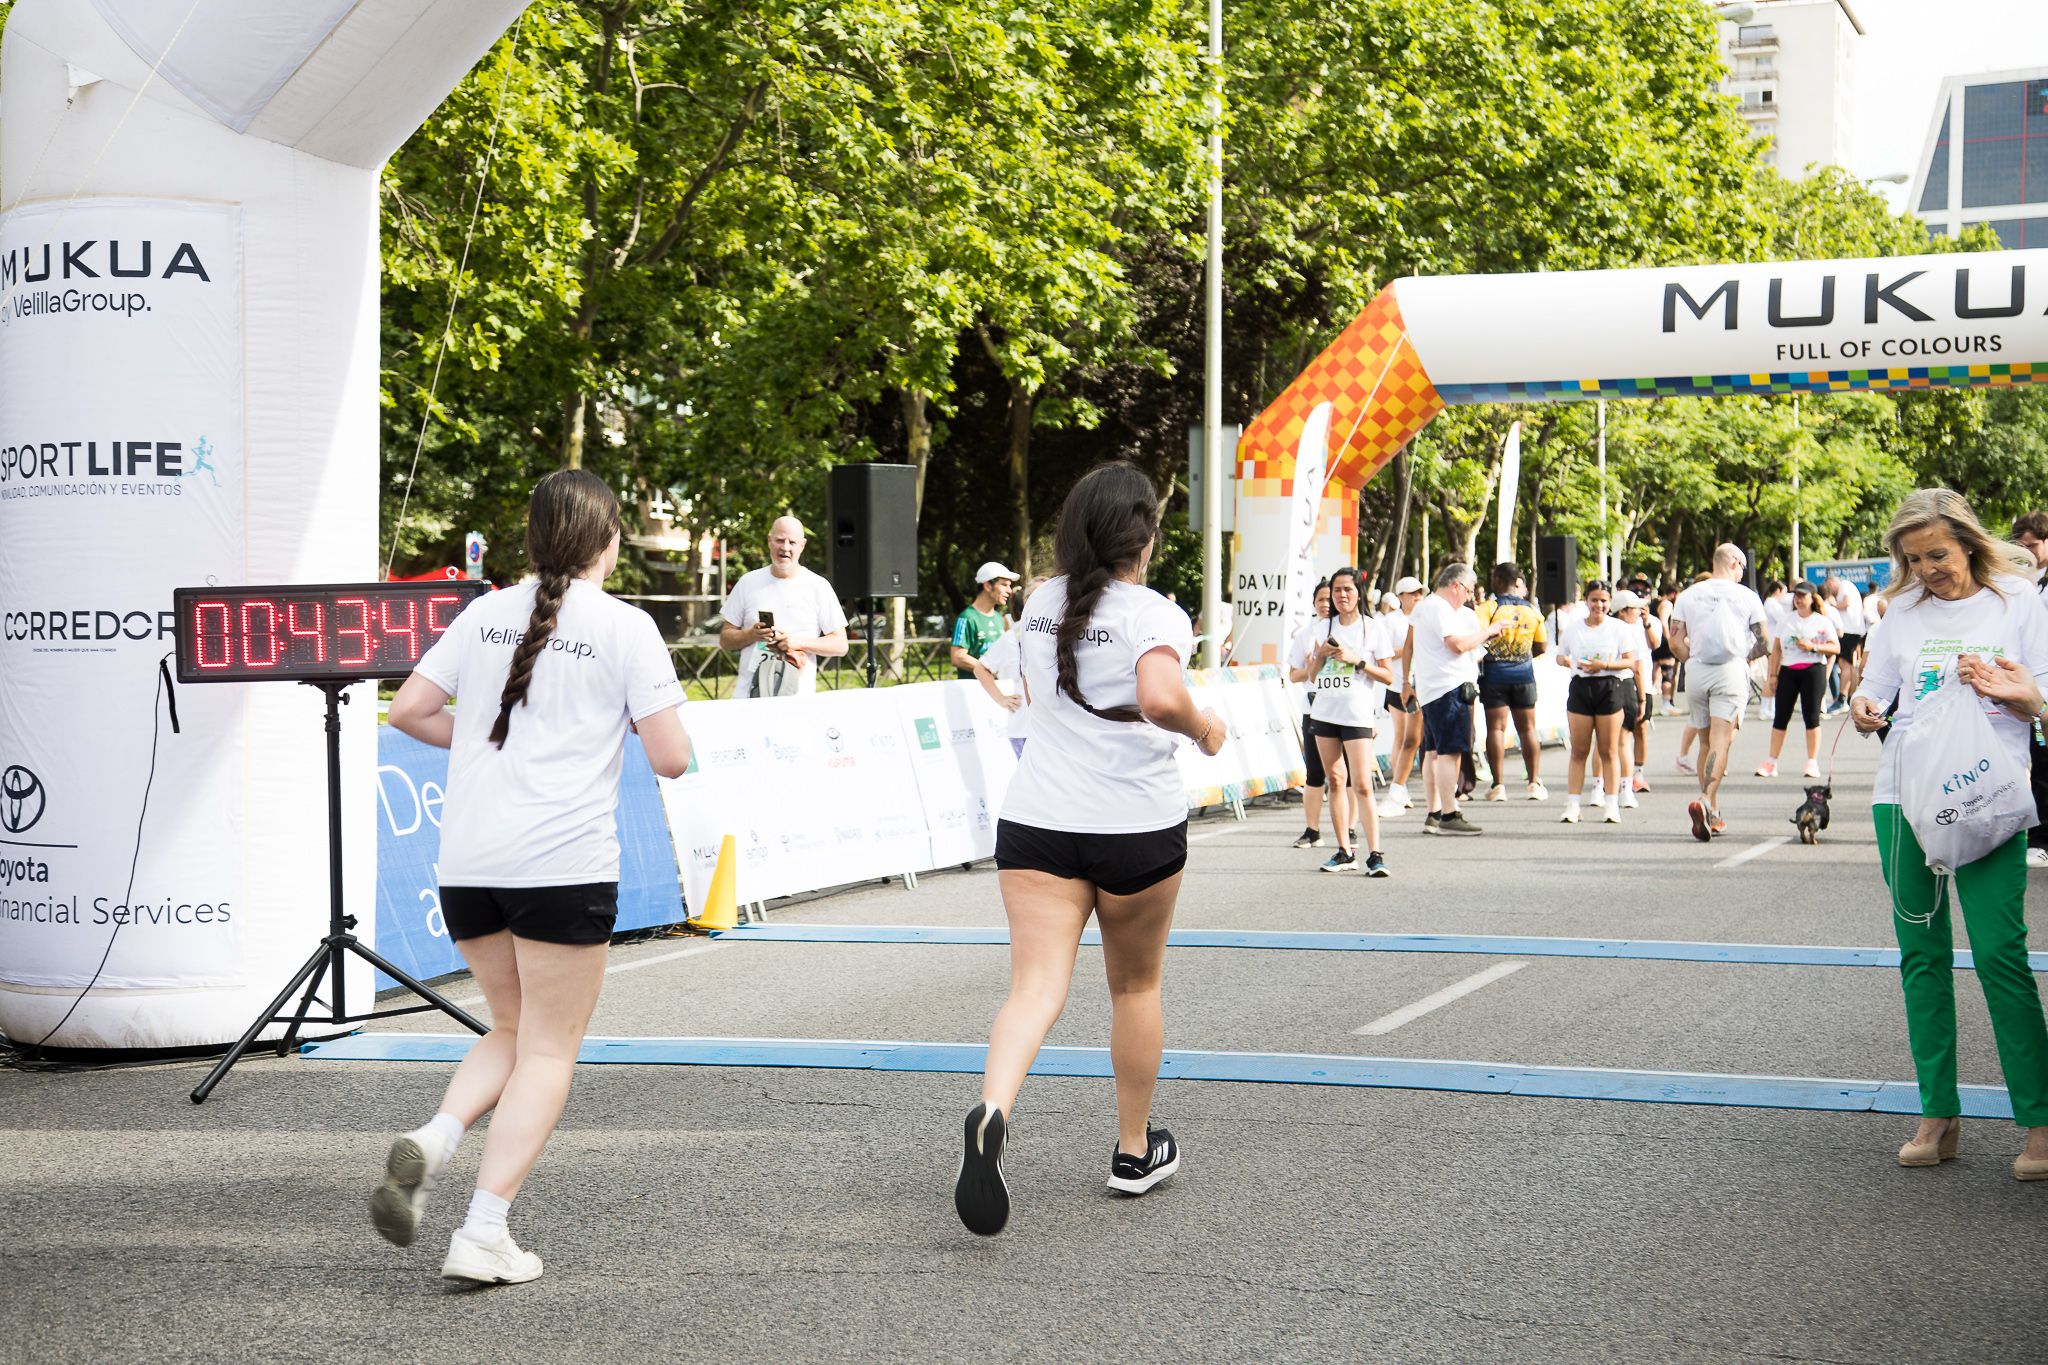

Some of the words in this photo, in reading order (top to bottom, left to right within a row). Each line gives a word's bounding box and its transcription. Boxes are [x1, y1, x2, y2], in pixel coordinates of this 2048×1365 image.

[2, 240, 211, 291] MUKUA
[14, 289, 151, 317] VelillaGroup.
[1662, 265, 2048, 332] MUKU
[1777, 342, 1830, 361] FULL
[1840, 340, 1871, 358] OF
[1881, 334, 2003, 356] COLOURS
[29, 481, 106, 497] COMUNICACIÓN
[110, 484, 117, 495] Y
[121, 484, 182, 496] EVENTOS
[1239, 574, 1257, 590] DA
[1237, 600, 1262, 617] TUS
[4, 611, 175, 641] CORREDOR
[1317, 677, 1351, 689] 1005
[92, 897, 231, 925] Services
